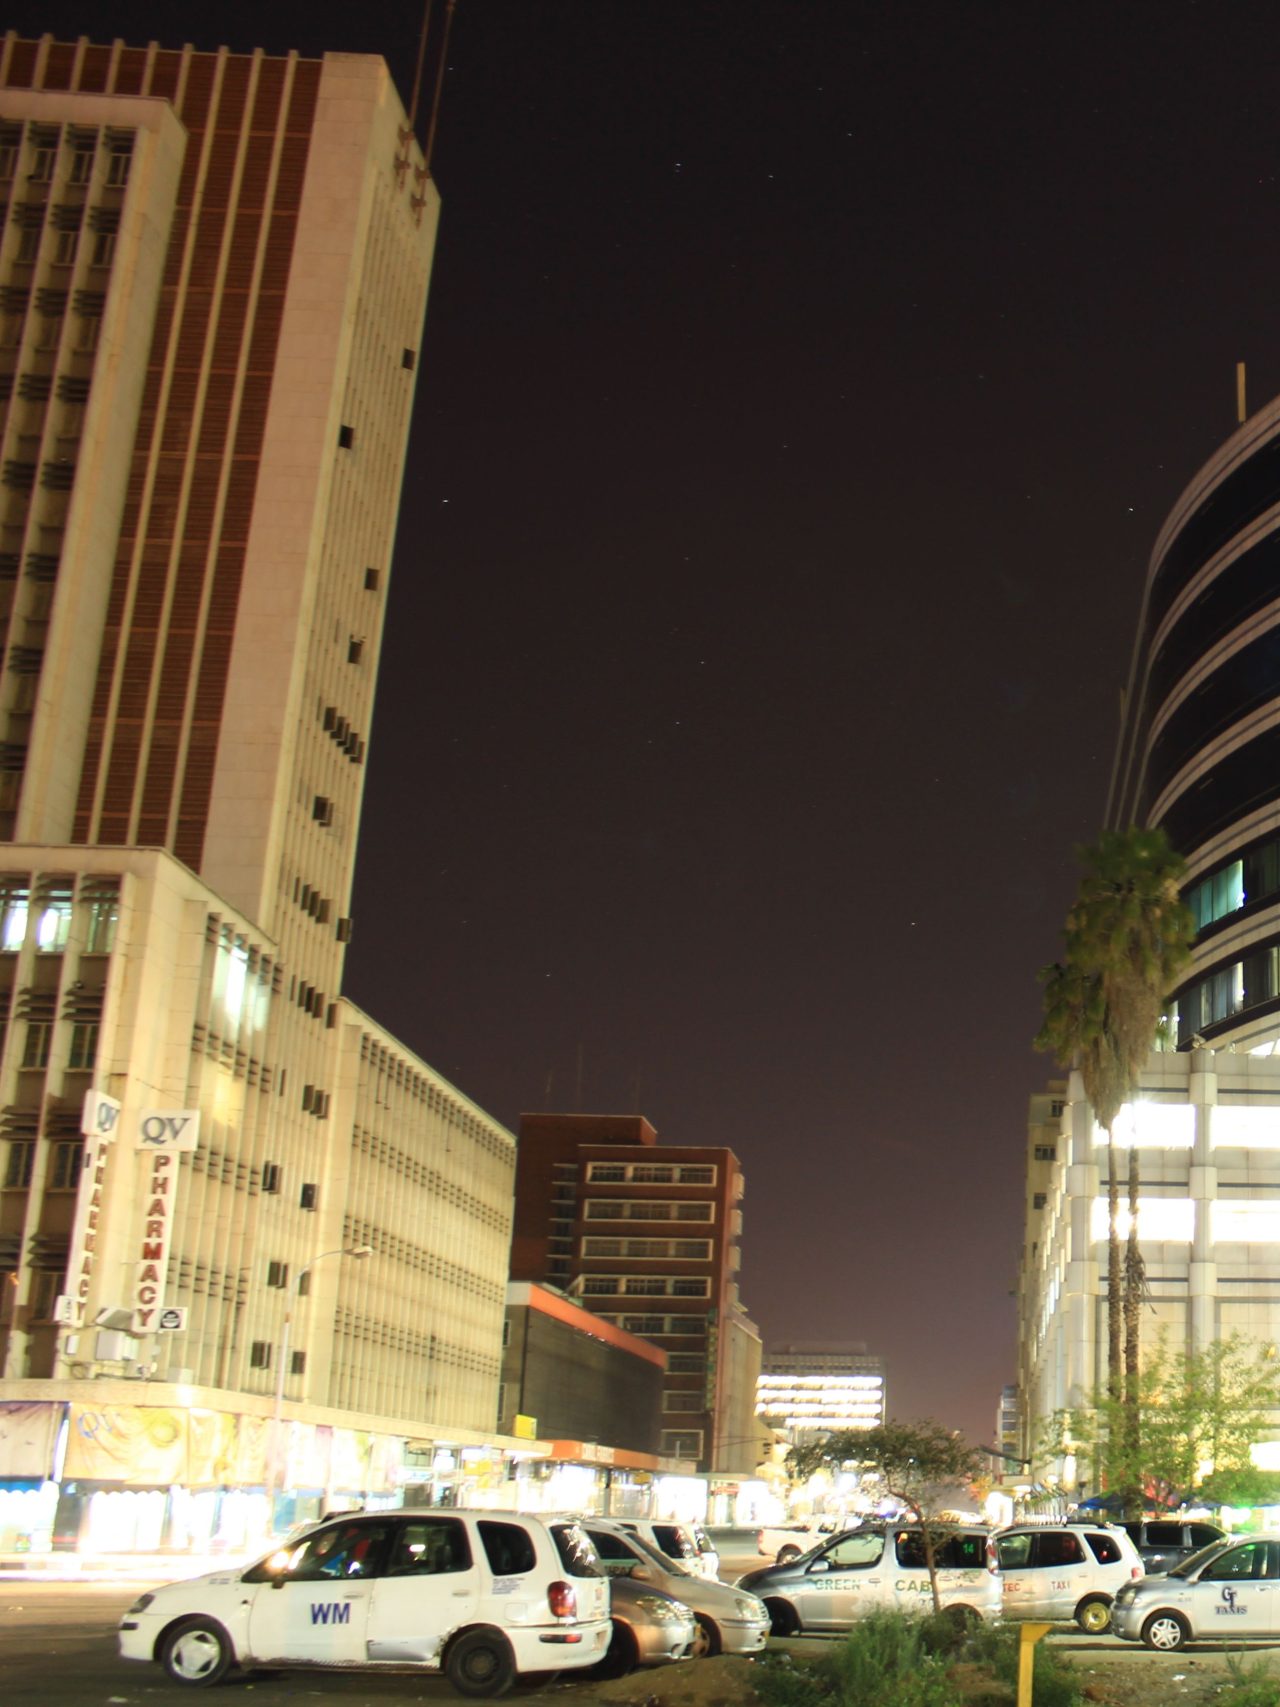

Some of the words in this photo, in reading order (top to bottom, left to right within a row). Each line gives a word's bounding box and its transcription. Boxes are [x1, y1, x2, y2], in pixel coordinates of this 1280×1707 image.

[142, 1116, 190, 1144] QV
[137, 1154, 170, 1328] PHARMACY
[815, 1578, 860, 1591] GREEN
[1051, 1581, 1070, 1590] TAXI
[311, 1602, 351, 1625] WM
[1214, 1605, 1248, 1615] TAXIS
